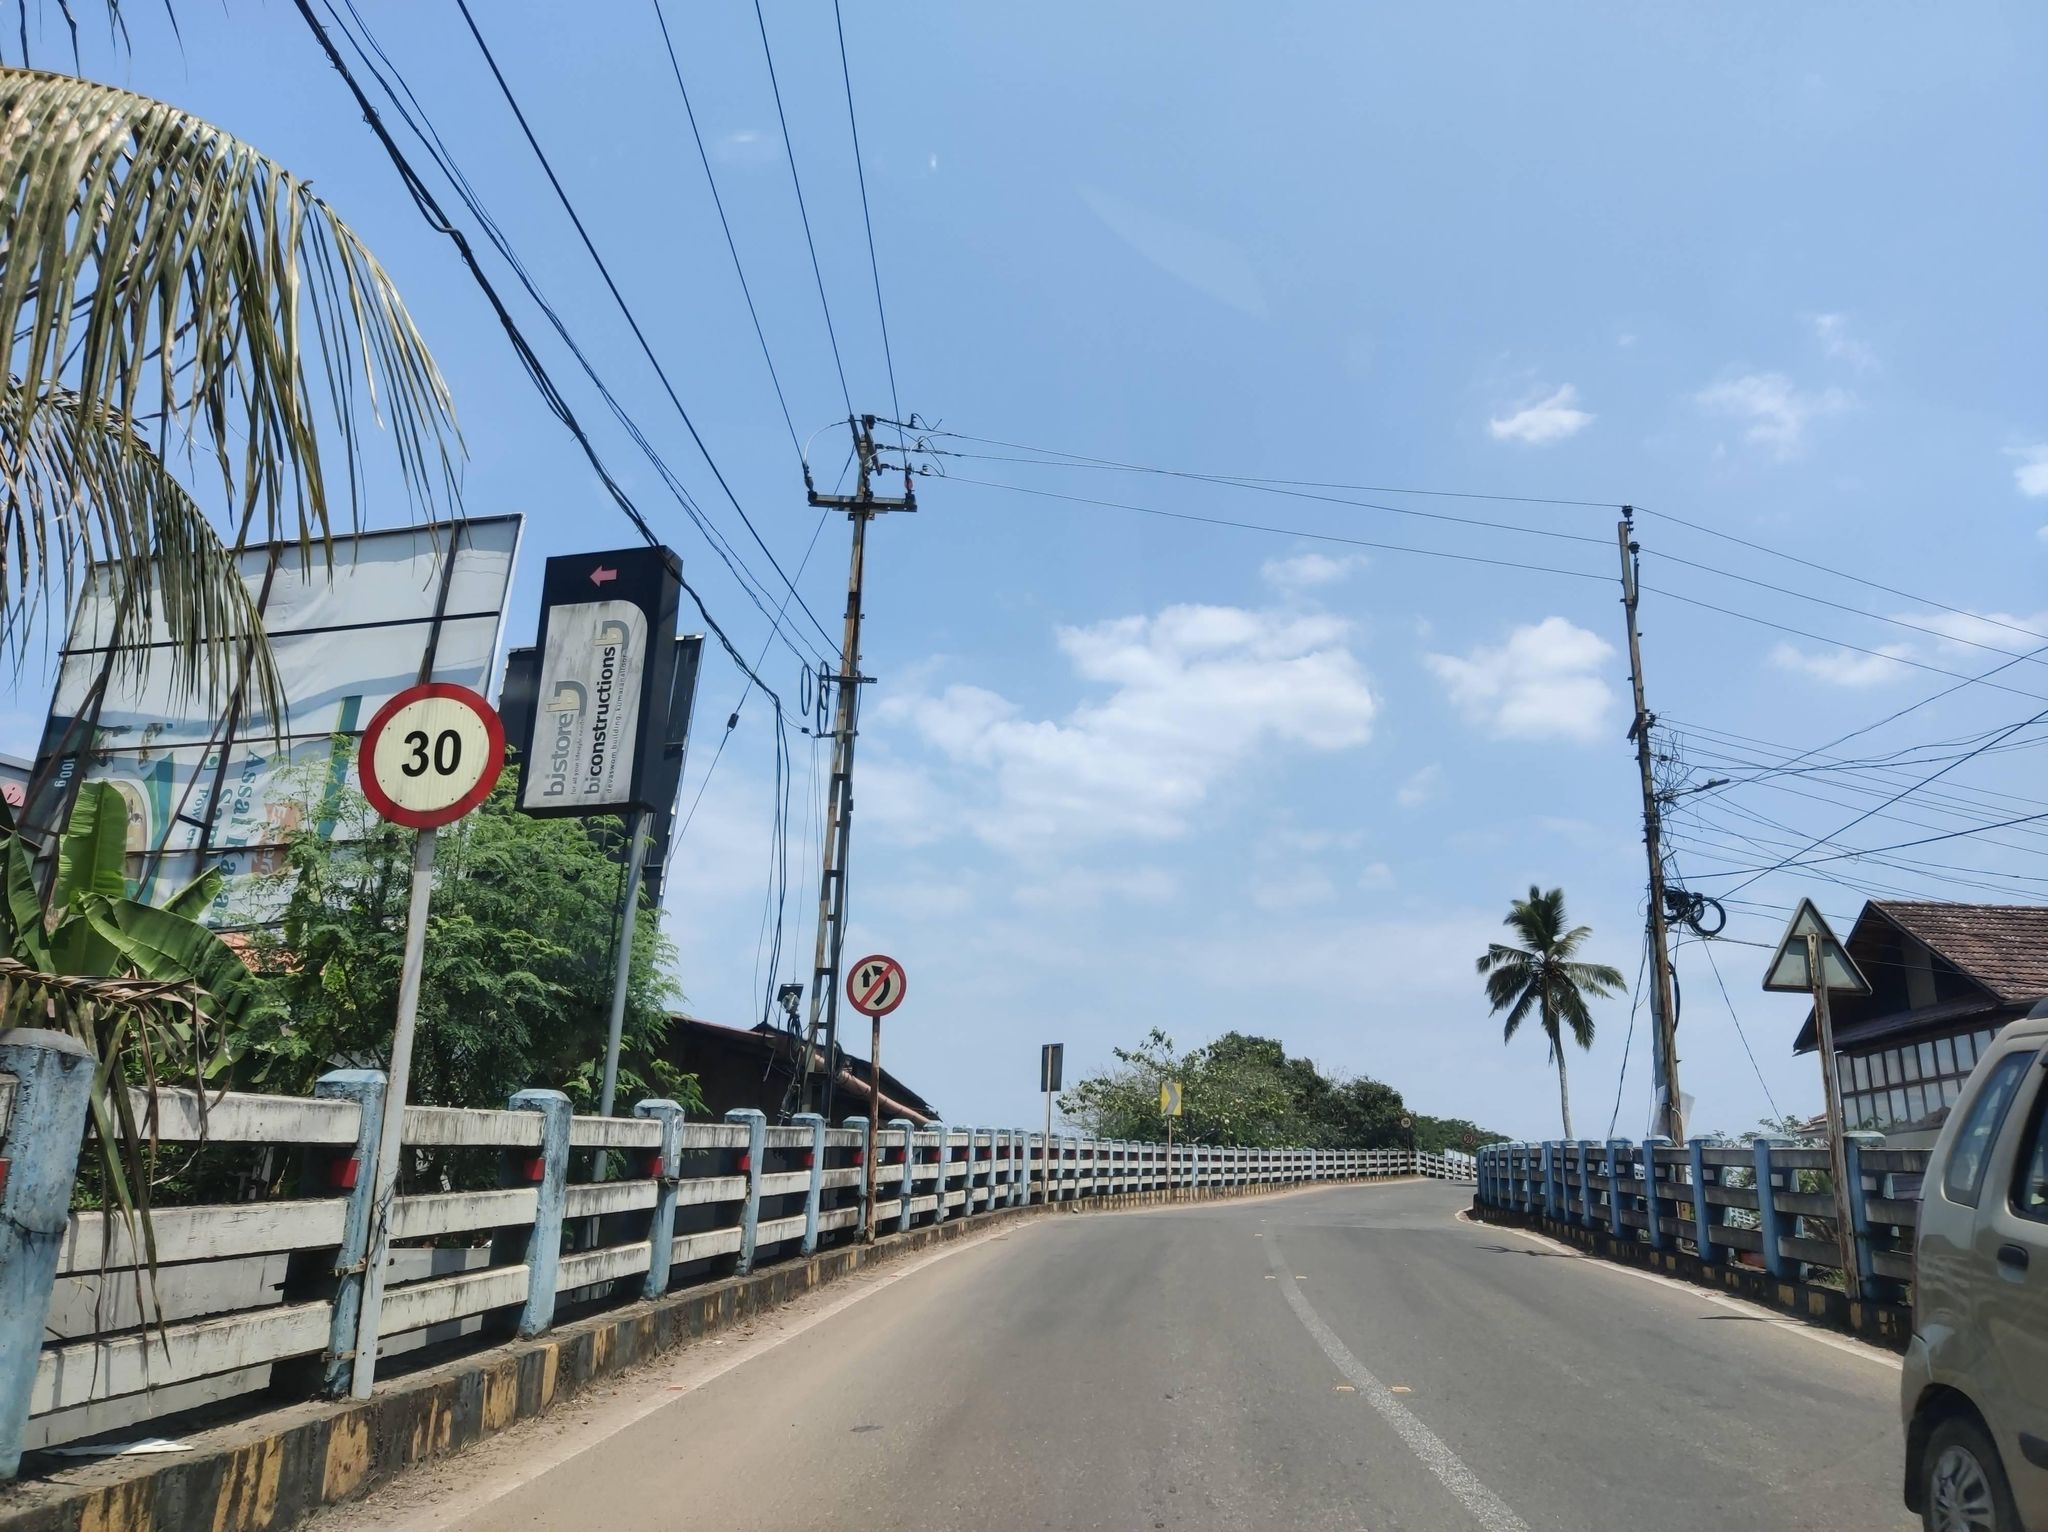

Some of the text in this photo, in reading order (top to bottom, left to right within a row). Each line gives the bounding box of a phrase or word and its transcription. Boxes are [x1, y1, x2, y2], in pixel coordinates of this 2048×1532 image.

[60, 758, 76, 778] 100
[401, 729, 462, 777] 30
[606, 752, 618, 794] devaswom
[231, 750, 266, 829] Assal
[186, 788, 210, 844] Power
